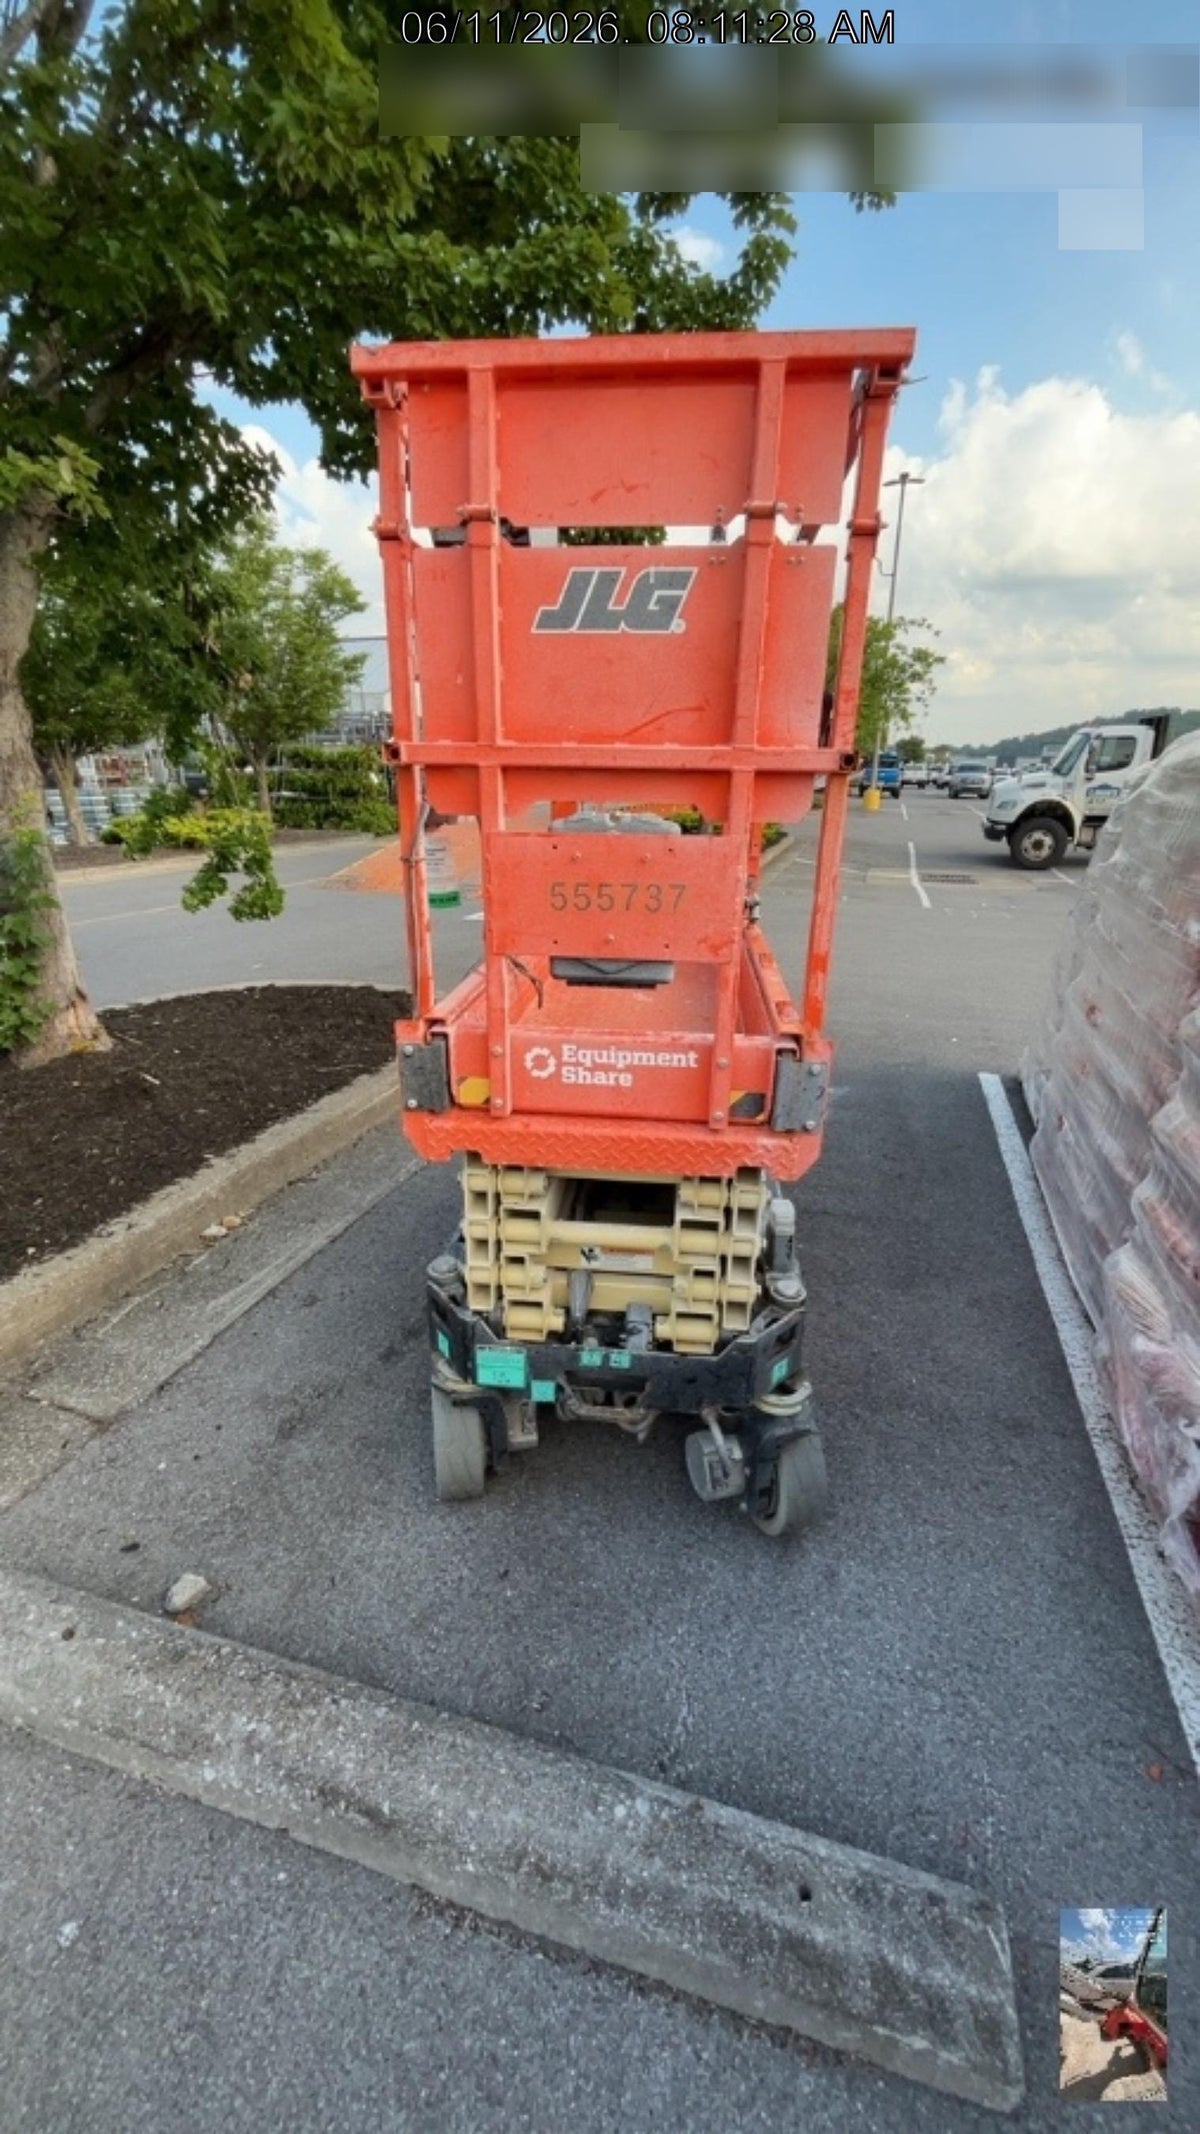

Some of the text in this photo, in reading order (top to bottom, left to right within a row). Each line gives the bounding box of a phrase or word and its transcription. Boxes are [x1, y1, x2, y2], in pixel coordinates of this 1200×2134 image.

[550, 881, 687, 914] 555737
[561, 1044, 698, 1069] Equipment
[561, 1066, 633, 1087] Share
